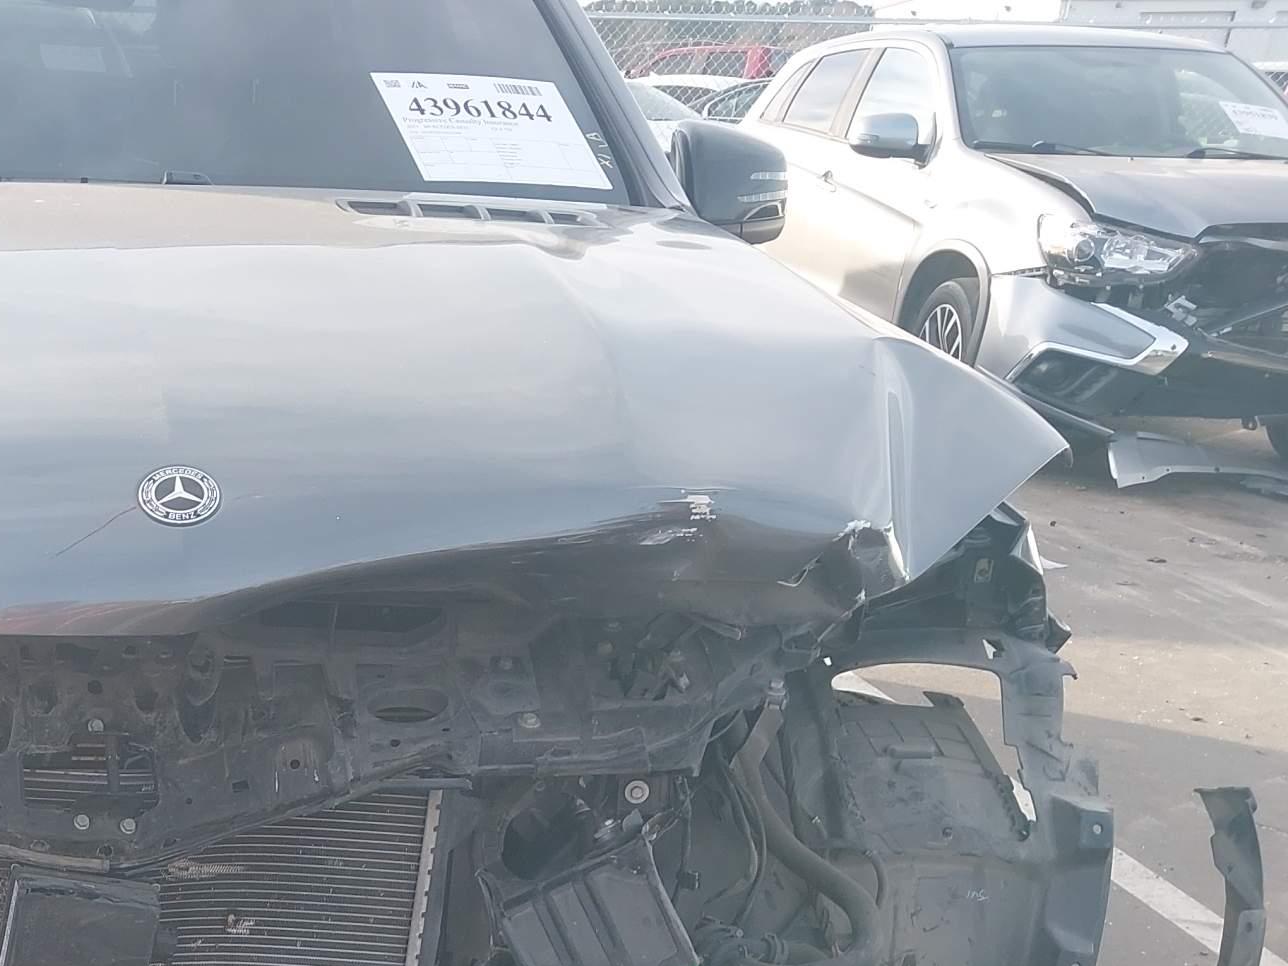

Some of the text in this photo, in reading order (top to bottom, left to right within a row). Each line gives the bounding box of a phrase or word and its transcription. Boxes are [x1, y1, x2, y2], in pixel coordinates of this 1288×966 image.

[408, 96, 553, 122] 43961844
[152, 468, 203, 481] MERCEDES
[168, 512, 197, 520] BENZ
